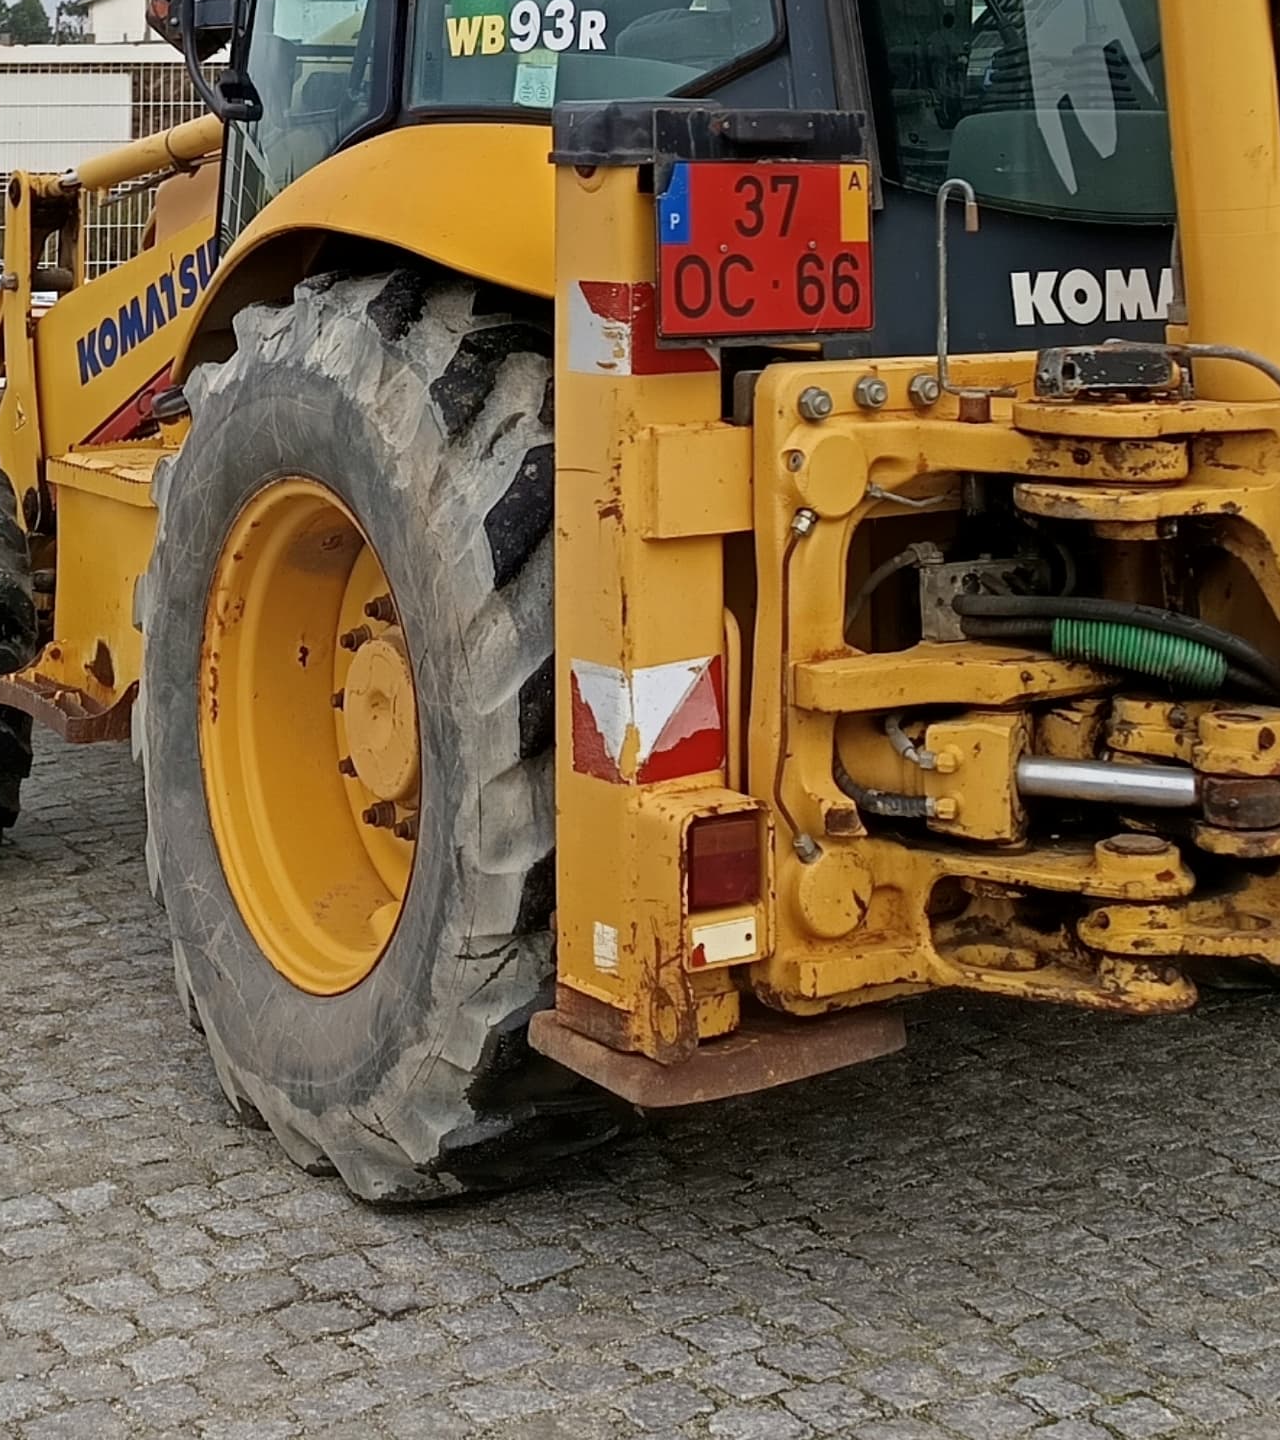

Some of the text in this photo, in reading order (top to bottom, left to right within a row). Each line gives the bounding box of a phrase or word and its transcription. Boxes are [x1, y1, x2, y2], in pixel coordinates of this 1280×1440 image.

[847, 170, 862, 192] A
[670, 213, 681, 231] P
[733, 175, 800, 238] 37
[76, 235, 221, 387] KOMATSU
